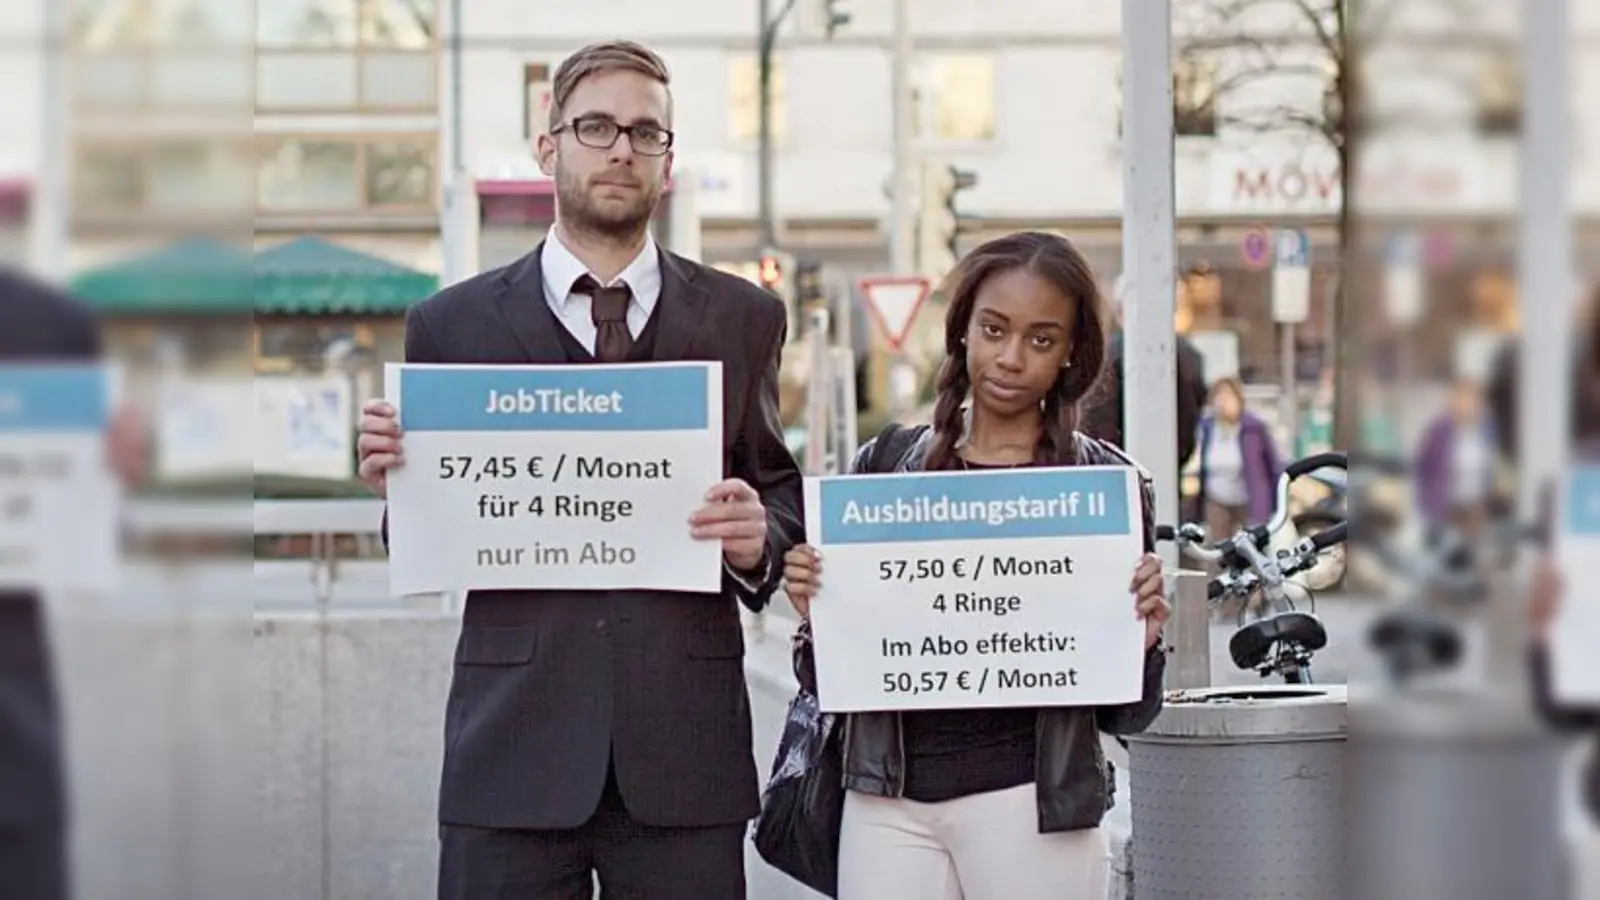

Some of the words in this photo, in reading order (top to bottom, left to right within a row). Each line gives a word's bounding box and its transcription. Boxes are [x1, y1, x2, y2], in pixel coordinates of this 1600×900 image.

[485, 388, 623, 415] JobTicket
[438, 456, 517, 482] 57,45
[526, 456, 544, 479] €
[551, 453, 567, 482] /
[576, 456, 672, 479] Monat
[477, 495, 519, 518] für
[528, 496, 545, 516] 4
[555, 495, 633, 522] Ringe
[842, 491, 1080, 525] Ausbildungstarif
[1088, 492, 1105, 517] II
[477, 547, 525, 566] nur
[534, 542, 569, 565] im
[579, 541, 637, 564] Abo
[879, 558, 945, 583] 57,50
[951, 558, 966, 578] €
[972, 555, 985, 581] /
[993, 555, 1074, 577] Monat
[932, 593, 947, 613] 4
[955, 592, 1022, 616] Ringe
[882, 637, 913, 657] Im
[920, 634, 969, 656] Abo
[976, 632, 1077, 654] effektiv:
[883, 671, 949, 696] 50,57
[956, 671, 971, 691] €
[977, 668, 990, 694] /
[997, 667, 1078, 689] Monat
